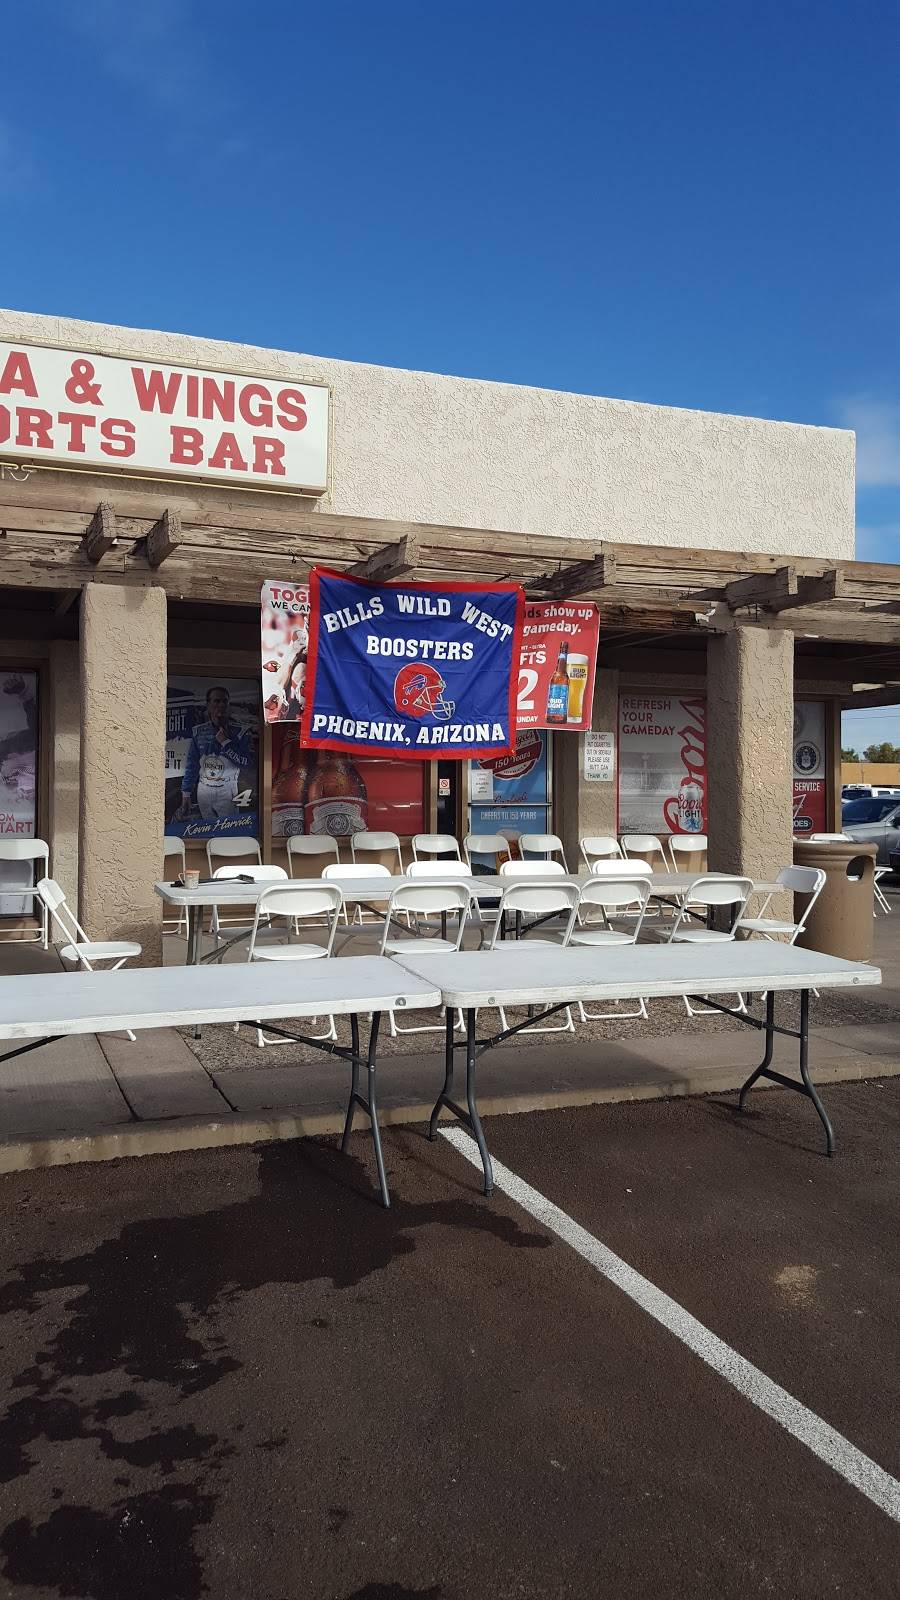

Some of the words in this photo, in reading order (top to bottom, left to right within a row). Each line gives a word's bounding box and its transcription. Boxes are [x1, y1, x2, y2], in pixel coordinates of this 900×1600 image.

[65, 358, 104, 406] &
[131, 366, 308, 432] WINGS
[169, 425, 286, 476] BAR
[271, 601, 288, 610] WE
[544, 605, 575, 618] show
[577, 608, 593, 620] up
[323, 597, 385, 633] BILLS
[397, 594, 451, 617] WILD
[460, 601, 513, 642] WEST
[523, 620, 581, 637] gameday.
[366, 635, 474, 660] BOOSTERS
[622, 699, 671, 710] REFRESH
[622, 711, 653, 722] YOUR
[312, 714, 411, 746] PHOENIX,
[416, 723, 505, 744] ARIZONA
[622, 724, 676, 736] GAMEDAY
[495, 757, 509, 769] 150
[795, 782, 821, 791] SERVICE
[232, 789, 252, 807] 4
[182, 822, 212, 837] Kevin
